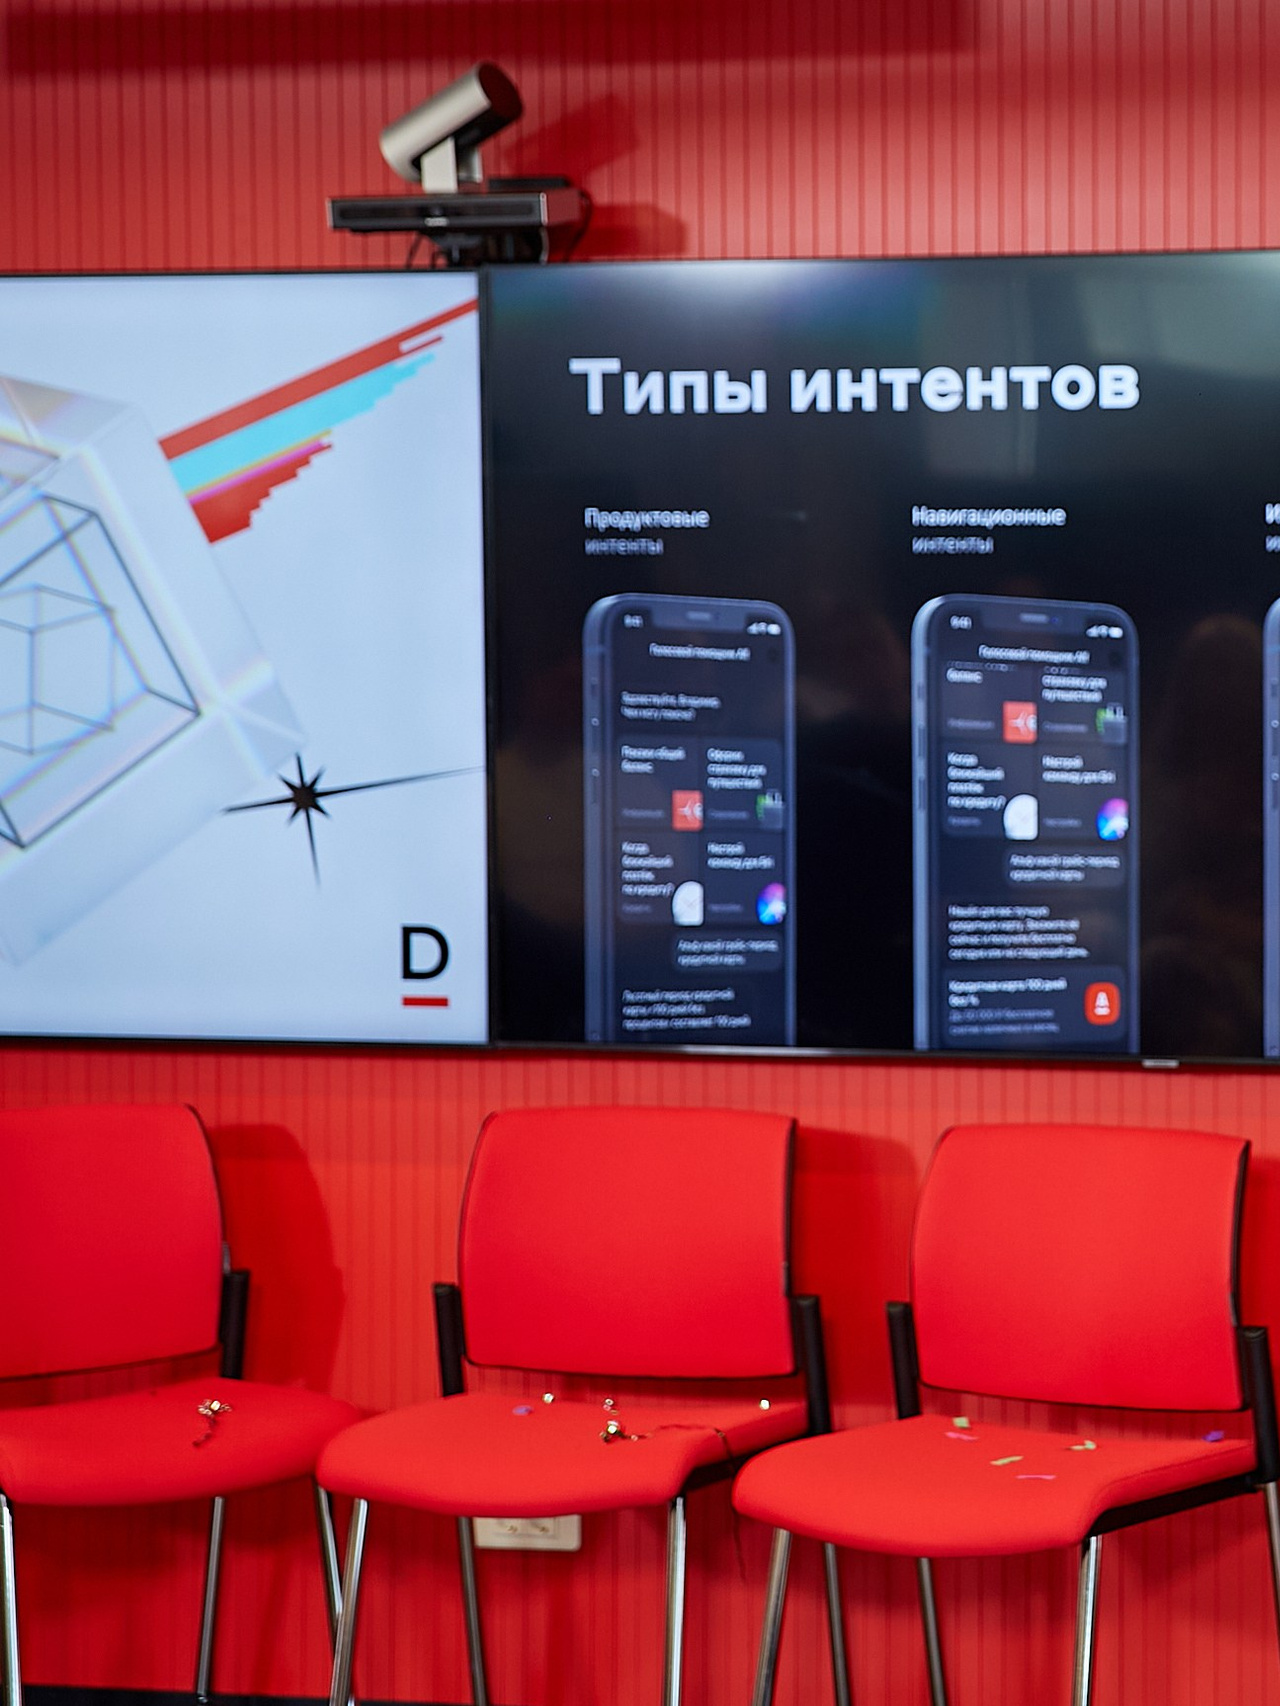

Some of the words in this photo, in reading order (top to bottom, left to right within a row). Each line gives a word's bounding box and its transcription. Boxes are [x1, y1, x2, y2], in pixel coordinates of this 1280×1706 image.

[569, 357, 768, 414] Типы
[790, 364, 1140, 413] интентов
[584, 506, 711, 532] Продуктовые
[911, 504, 1067, 530] Навигационные
[584, 536, 664, 556] интенты
[911, 535, 994, 555] интенты
[402, 926, 449, 980] D
